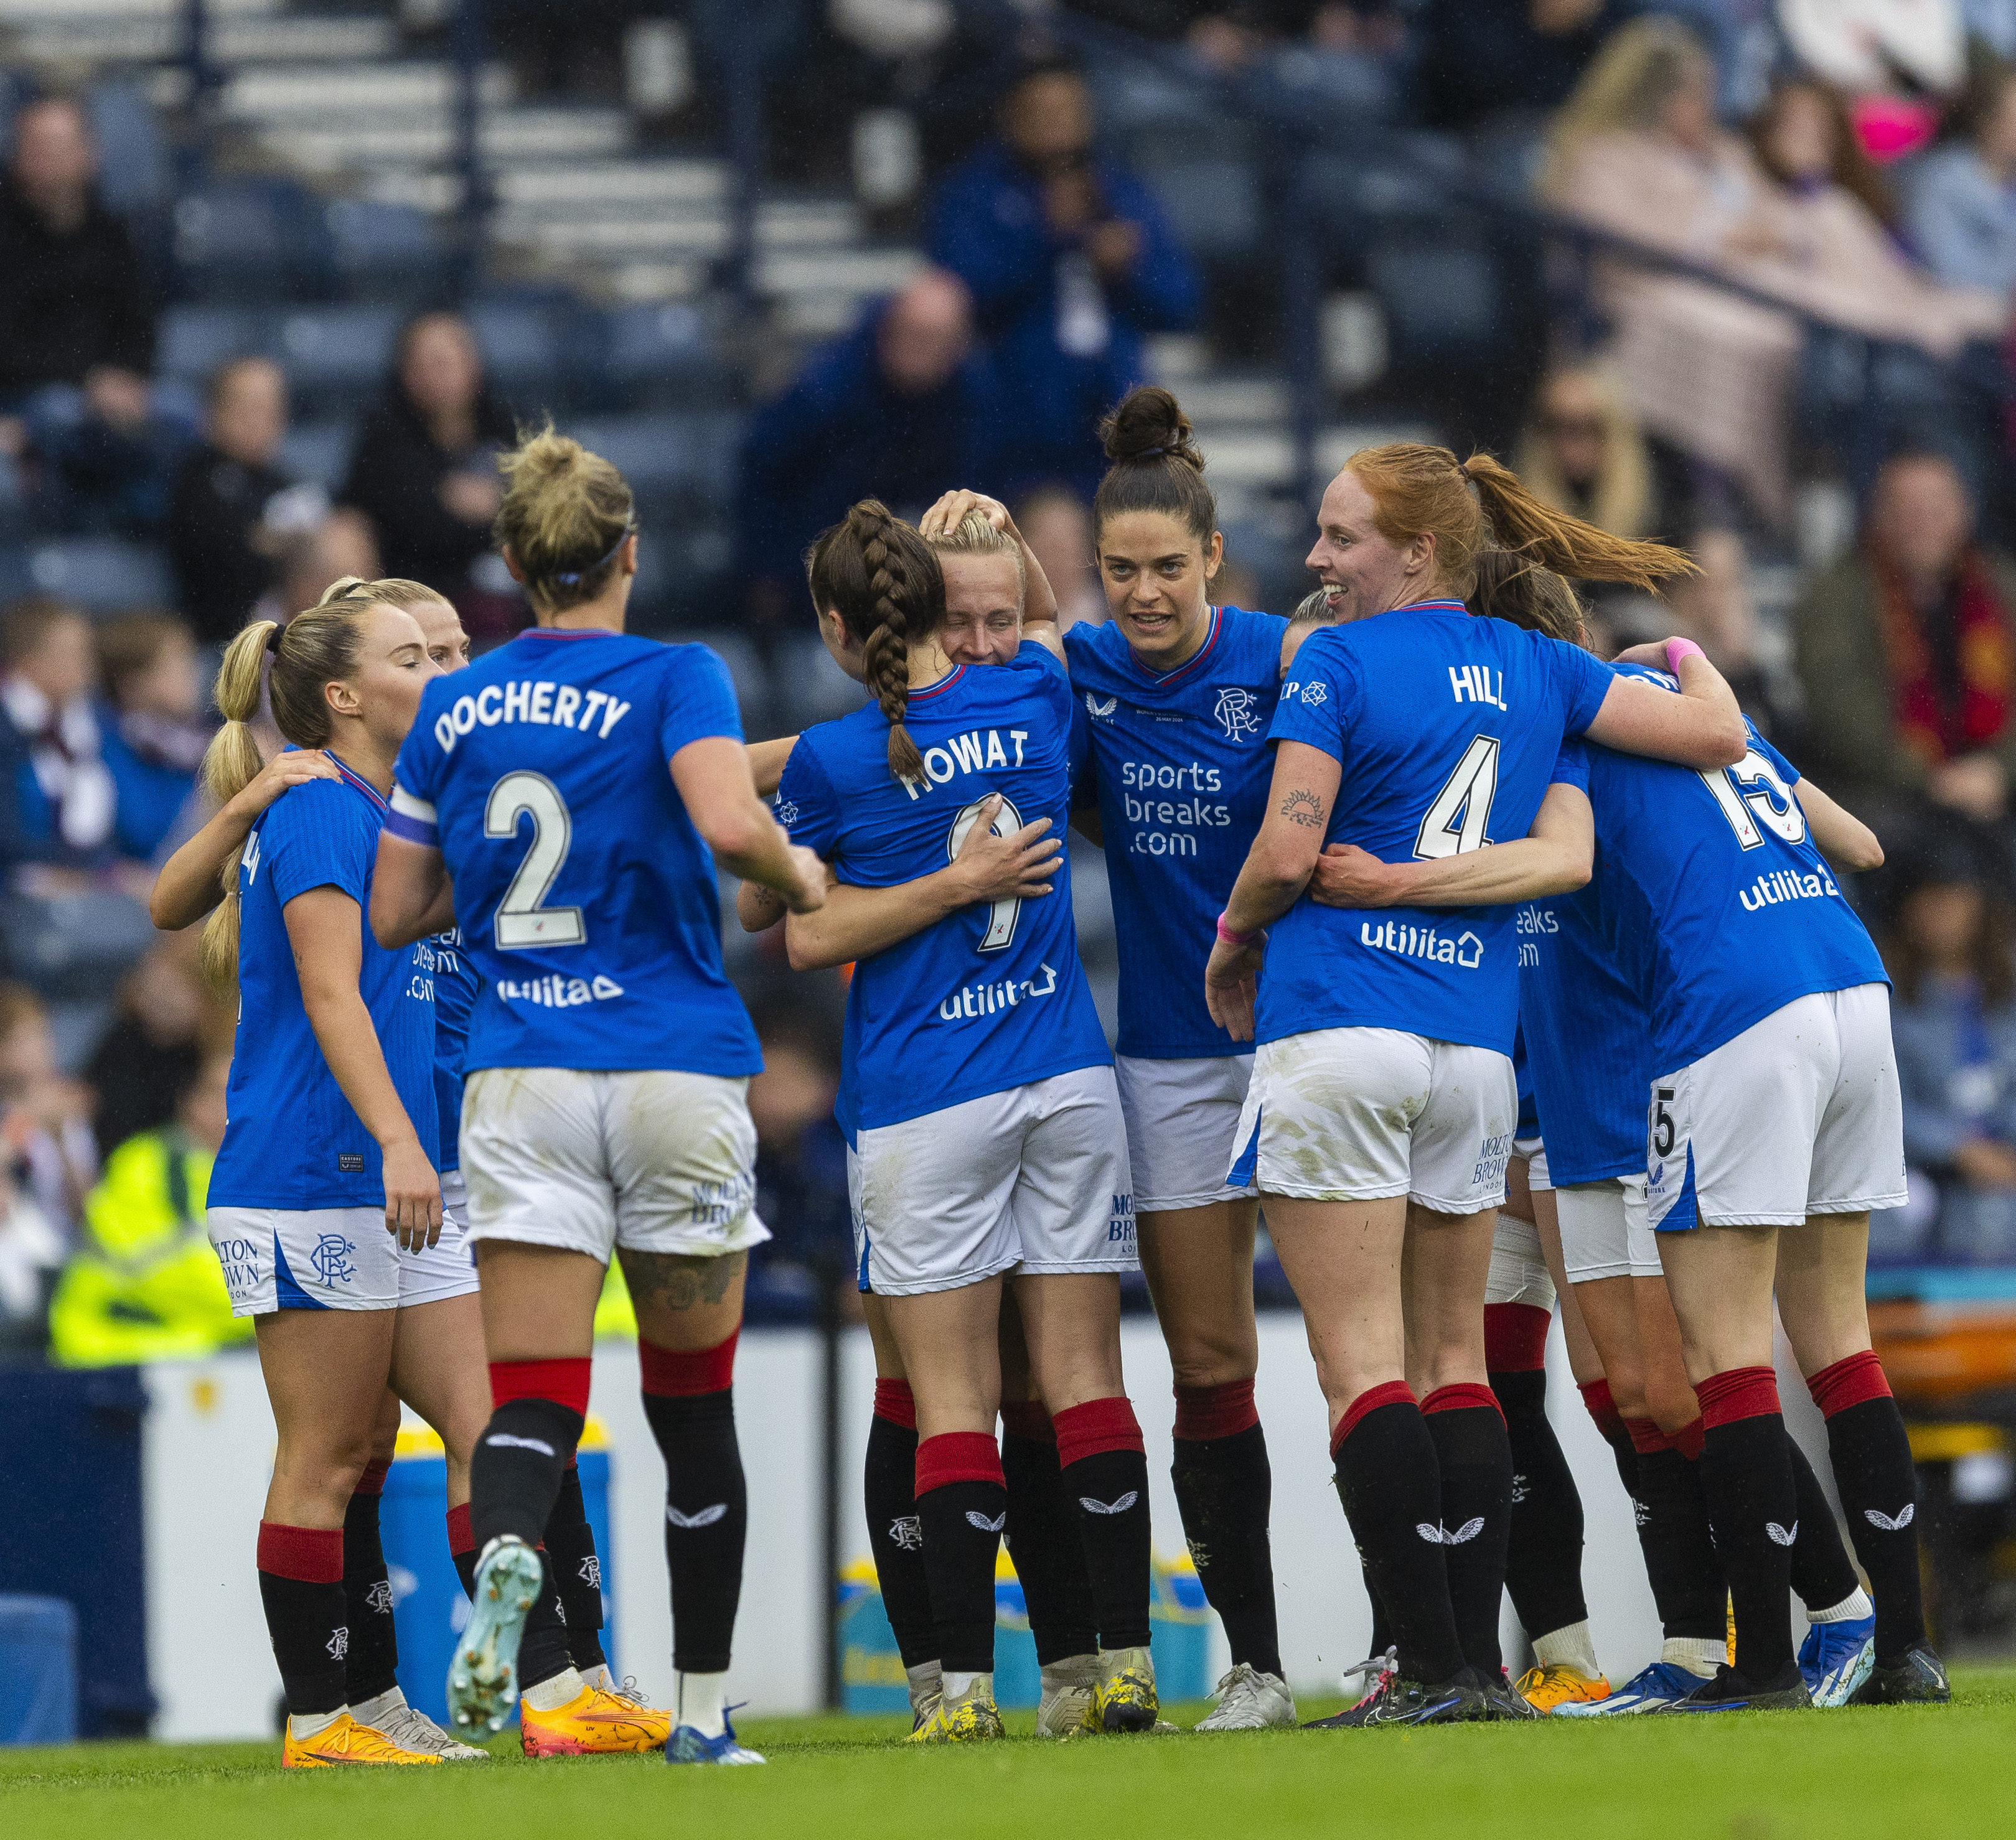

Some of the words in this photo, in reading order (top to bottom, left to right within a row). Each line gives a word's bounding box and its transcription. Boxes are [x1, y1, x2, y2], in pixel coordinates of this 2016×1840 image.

[1448, 666, 1507, 711] HILL
[434, 681, 631, 754] DOCHERTY
[894, 730, 1028, 801] HOWAT
[1122, 762, 1221, 791] sports
[1696, 719, 1806, 852] 15
[1125, 793, 1231, 826] breaks
[1412, 734, 1500, 861] 4
[484, 769, 587, 951] 2
[1130, 832, 1196, 856] .com
[1739, 869, 1824, 911] utilita
[1361, 920, 1455, 964] utilita
[1648, 1086, 1676, 1160] 5
[1472, 1156, 1508, 1184] BROW
[214, 1239, 258, 1263] LTON
